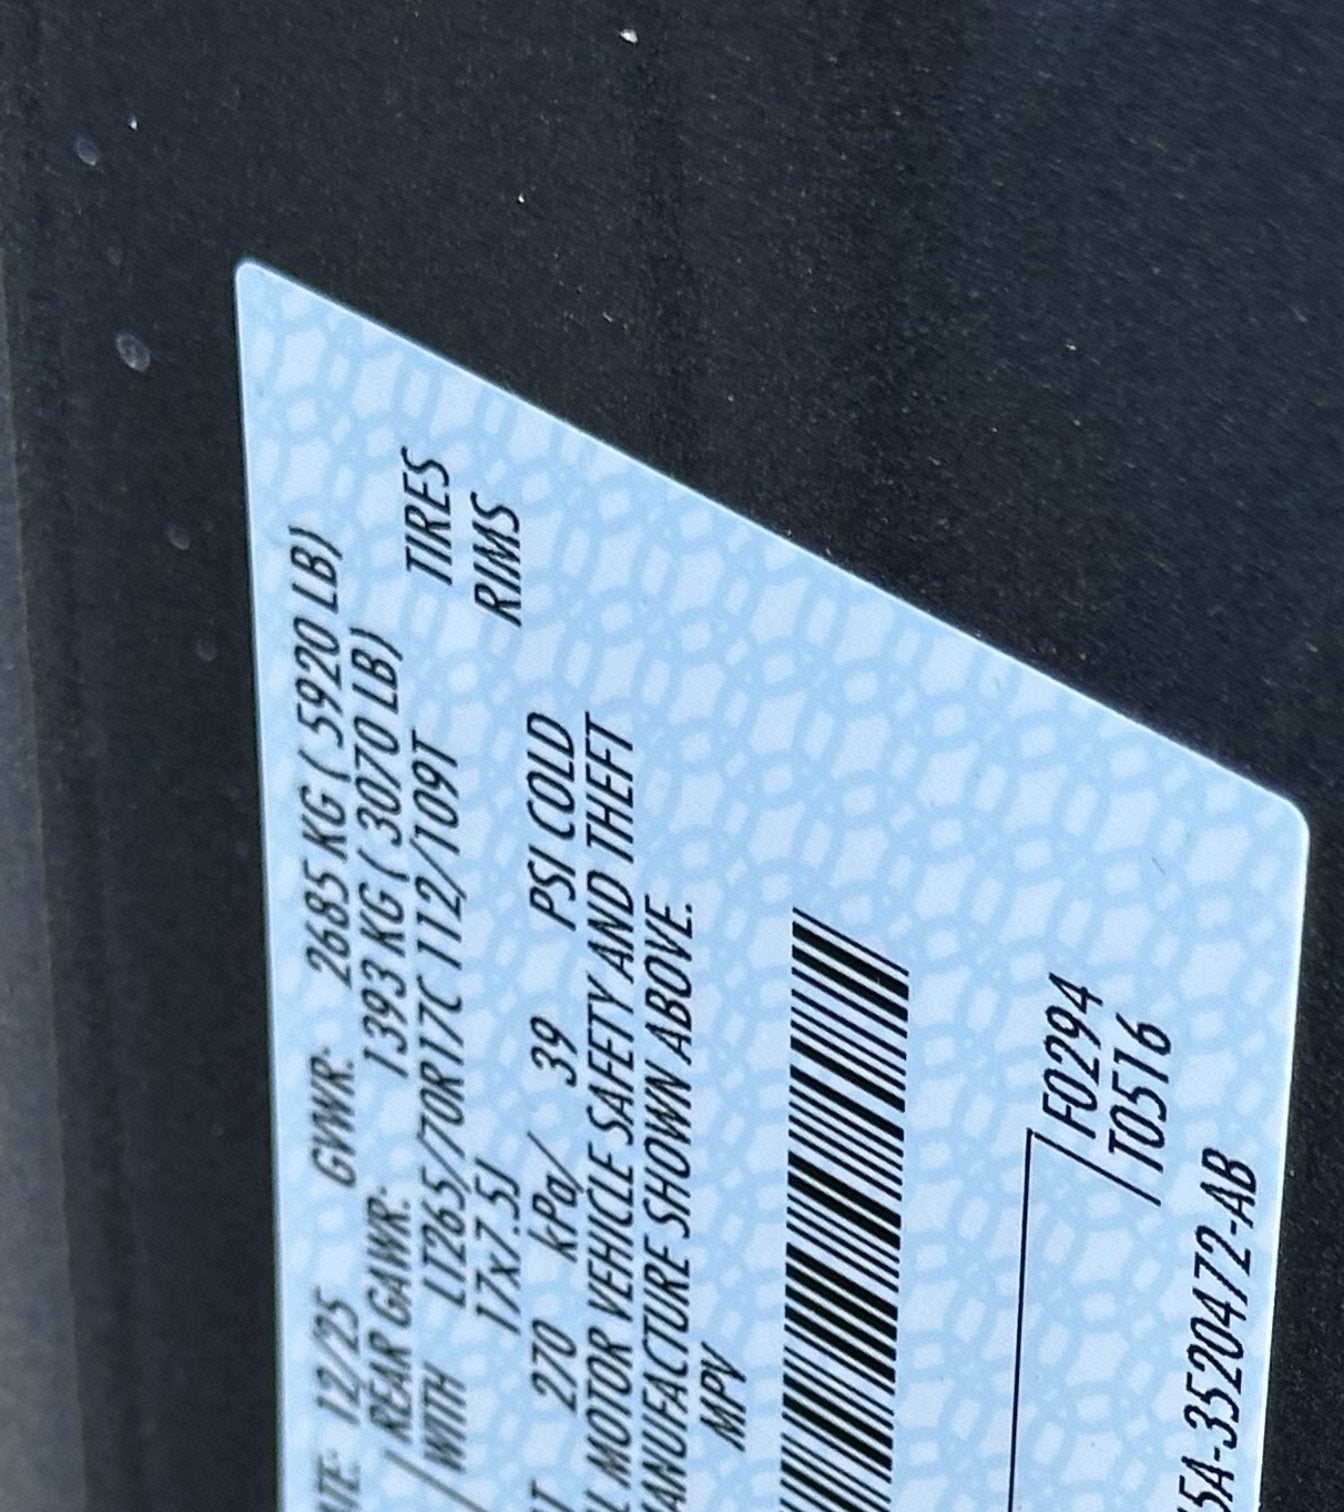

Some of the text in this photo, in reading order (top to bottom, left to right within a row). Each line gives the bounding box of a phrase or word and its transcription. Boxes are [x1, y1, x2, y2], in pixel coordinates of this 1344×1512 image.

[287, 524, 343, 613] LB)
[400, 444, 454, 585] TIRES
[469, 490, 522, 626] RIMS
[290, 614, 344, 747] 5920
[348, 625, 405, 714] LB)
[298, 782, 349, 860] KG
[351, 713, 403, 846] 3070
[525, 708, 577, 842] COLD
[584, 708, 635, 864] THEFT
[303, 859, 353, 988] 2685
[356, 881, 407, 957] KG
[527, 842, 579, 933] PSI
[585, 866, 636, 984] AND
[358, 965, 410, 1078] 1393
[644, 891, 695, 1065] ABOVE.
[308, 1045, 357, 1187] GVWR:
[406, 727, 468, 1472] WITH LT265/70R17C 112/109T
[529, 1014, 580, 1088] 39
[586, 973, 636, 1146] SAFETY
[1041, 970, 1104, 1139] F0294
[1107, 1010, 1173, 1174] T0516
[526, 1127, 584, 1264] kPa/
[644, 1057, 694, 1239] SHOWN
[362, 1183, 414, 1327] GAWR:
[473, 1154, 524, 1335] 17x7.5J
[585, 1140, 636, 1323] VEHICLE
[312, 1285, 363, 1428] 12/25
[365, 1327, 413, 1443] REAR
[529, 1315, 581, 1415] 270
[584, 1324, 634, 1490] MOTOR
[698, 1338, 748, 1452] MPV
